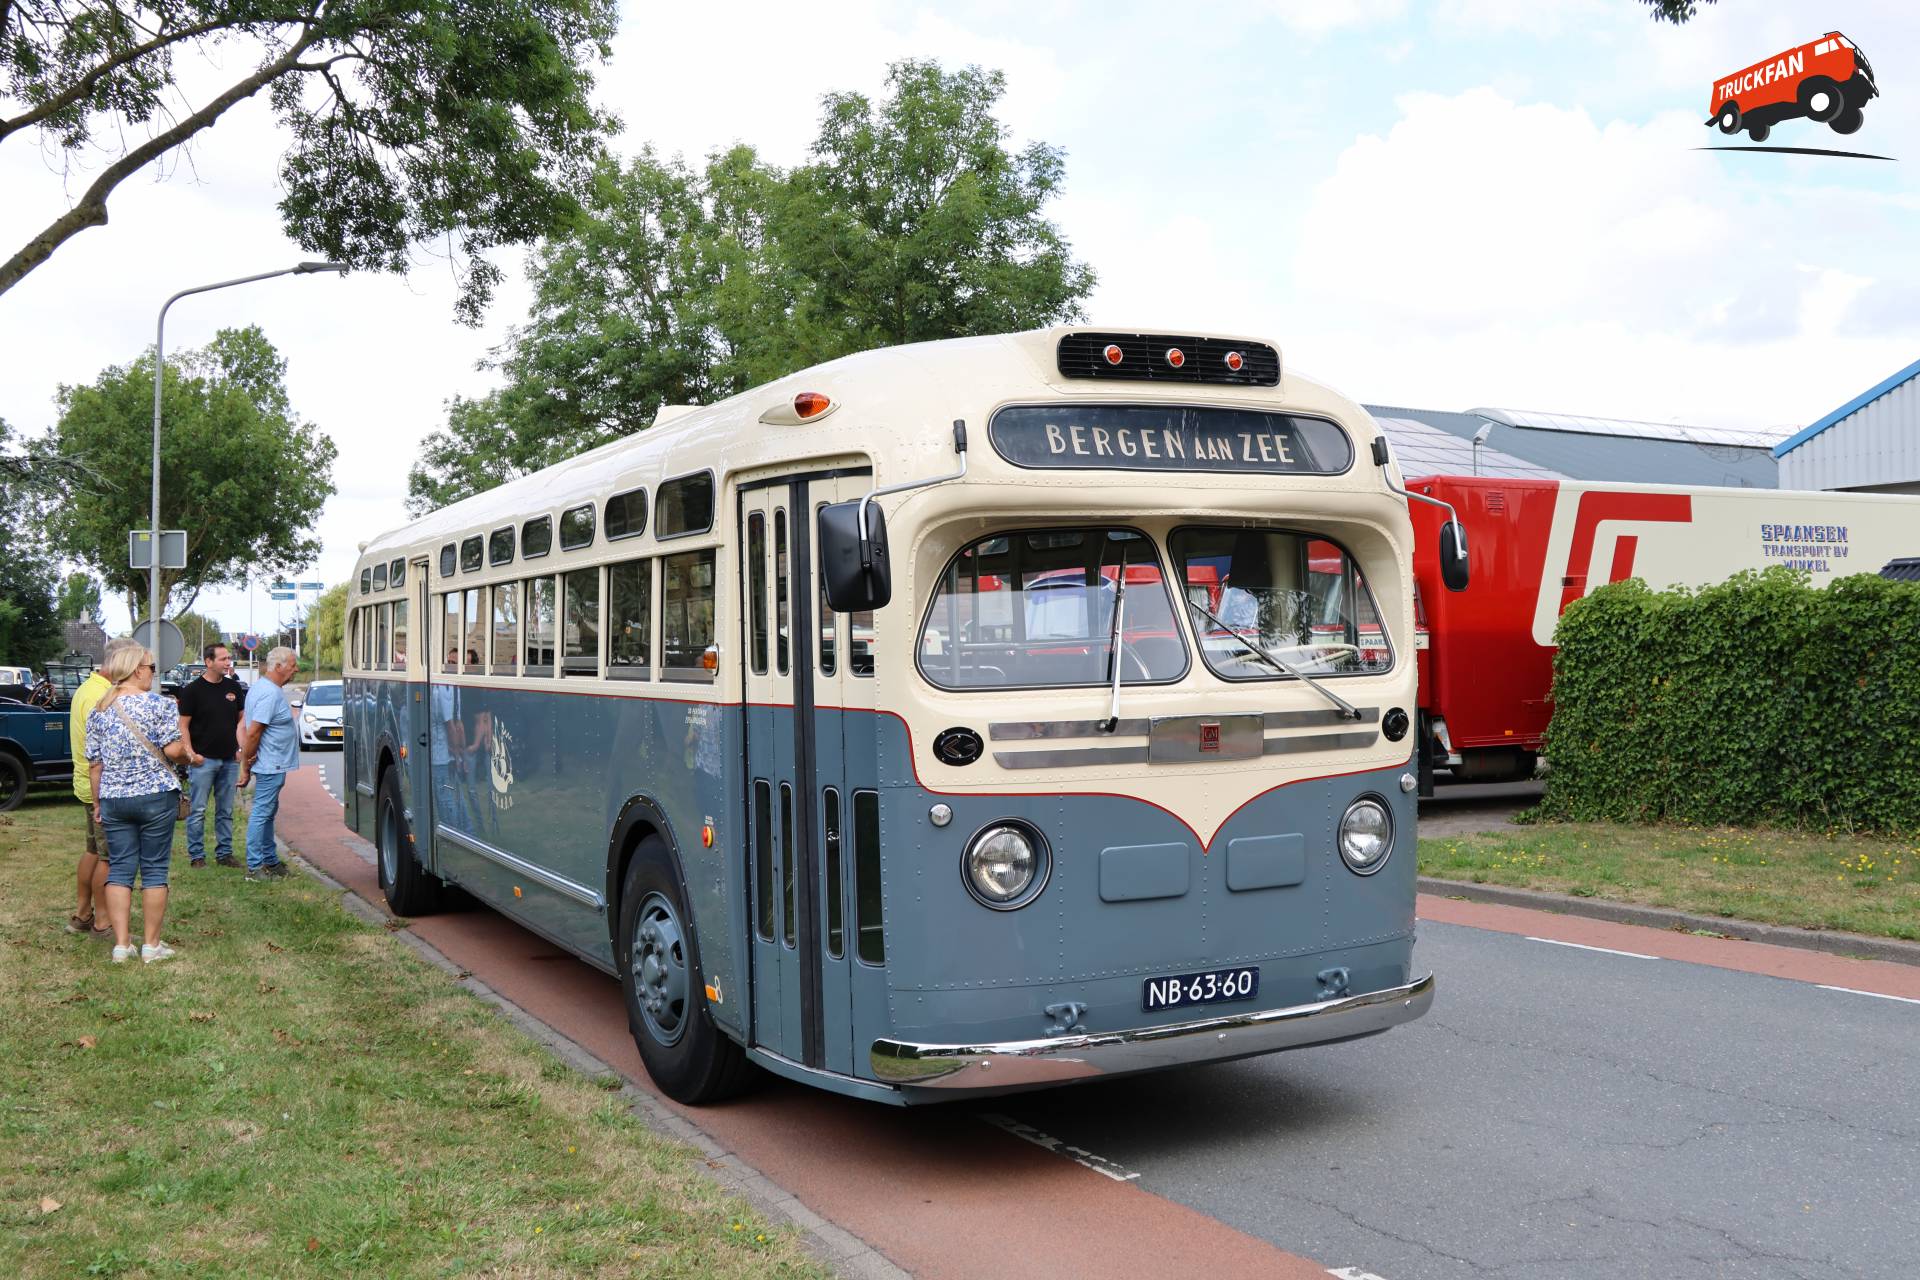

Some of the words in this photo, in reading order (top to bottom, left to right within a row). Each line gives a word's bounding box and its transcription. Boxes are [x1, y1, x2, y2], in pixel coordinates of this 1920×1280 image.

[1045, 424, 1186, 460] BERGEN
[1195, 437, 1234, 461] AAN
[1238, 433, 1295, 464] ZEE
[1761, 524, 1849, 543] SPAANSEN
[1762, 544, 1832, 558] TRANSPORT
[1833, 546, 1849, 558] BV
[1783, 559, 1830, 572] WINKEL
